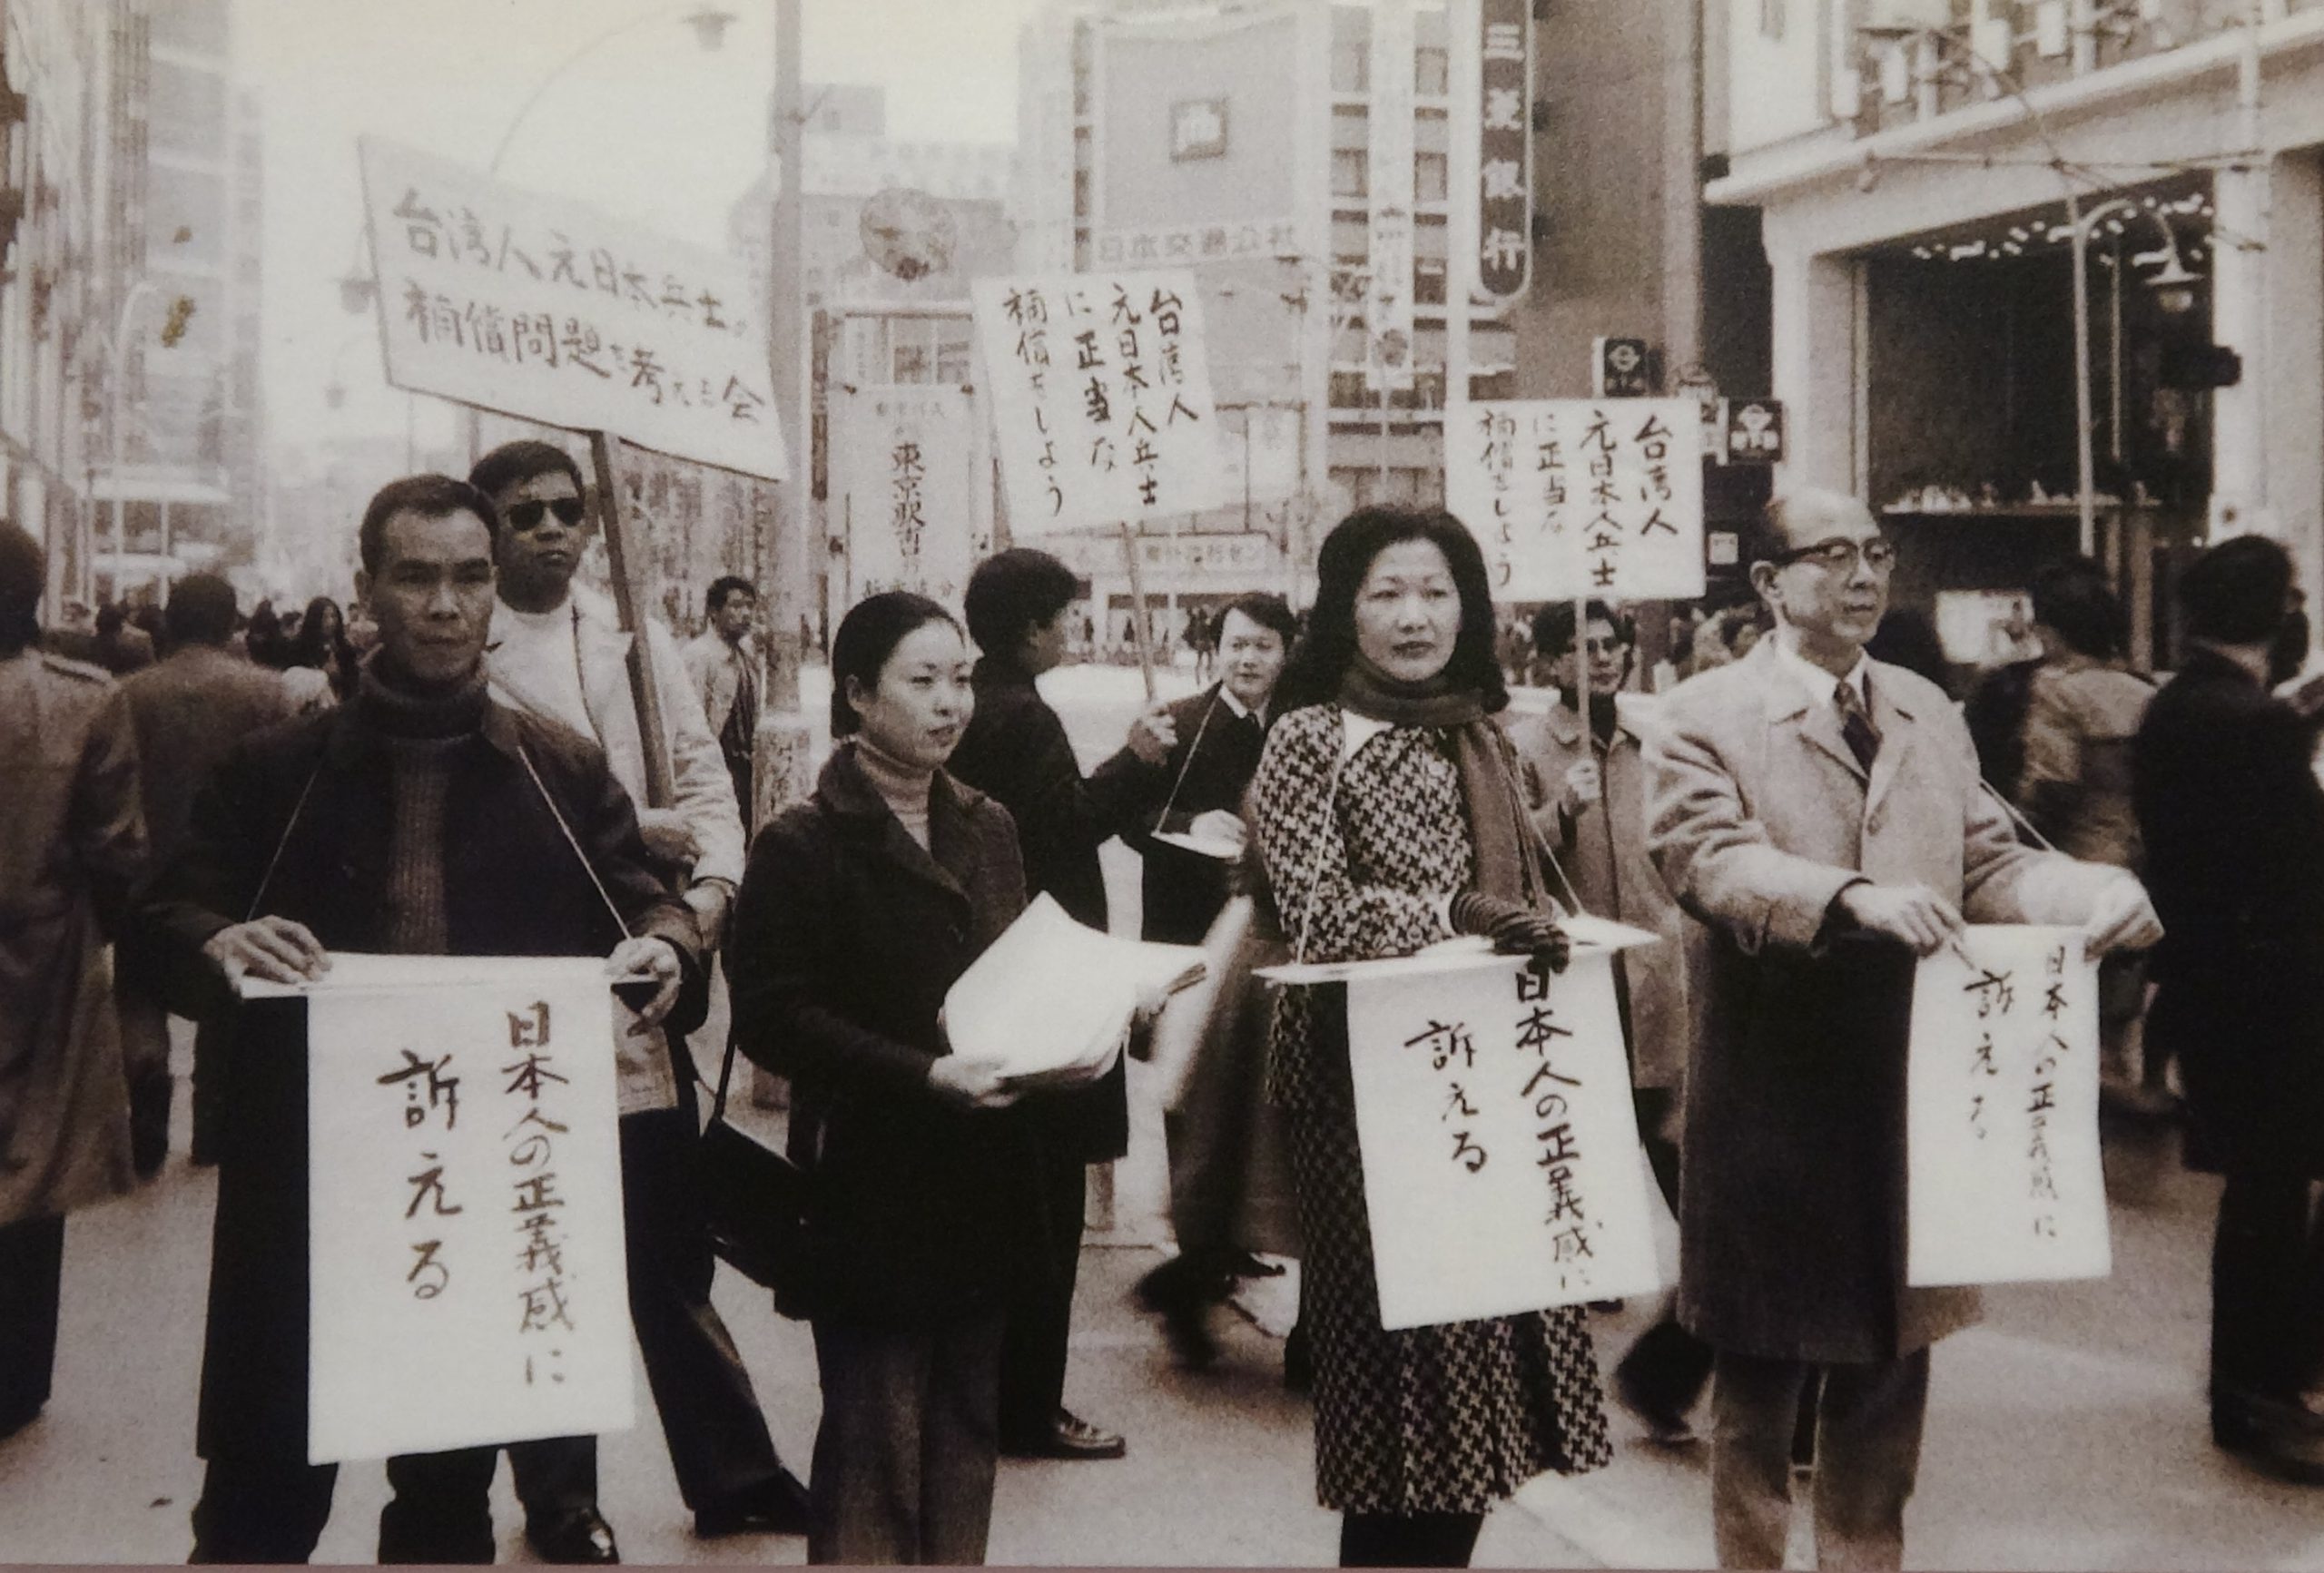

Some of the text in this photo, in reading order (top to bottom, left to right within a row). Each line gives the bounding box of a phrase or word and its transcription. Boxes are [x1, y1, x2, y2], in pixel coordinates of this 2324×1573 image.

[1110, 282, 1159, 506] 元日本人兵士
[1580, 409, 1623, 587] 元日本人兵士
[1404, 1018, 1487, 1174] 訴える
[1514, 969, 1603, 1290] 日本人の正義感に
[1962, 968, 2015, 1141] 訴える
[377, 1048, 463, 1301] 訴える
[502, 1000, 575, 1385] 日本人の正義感に
